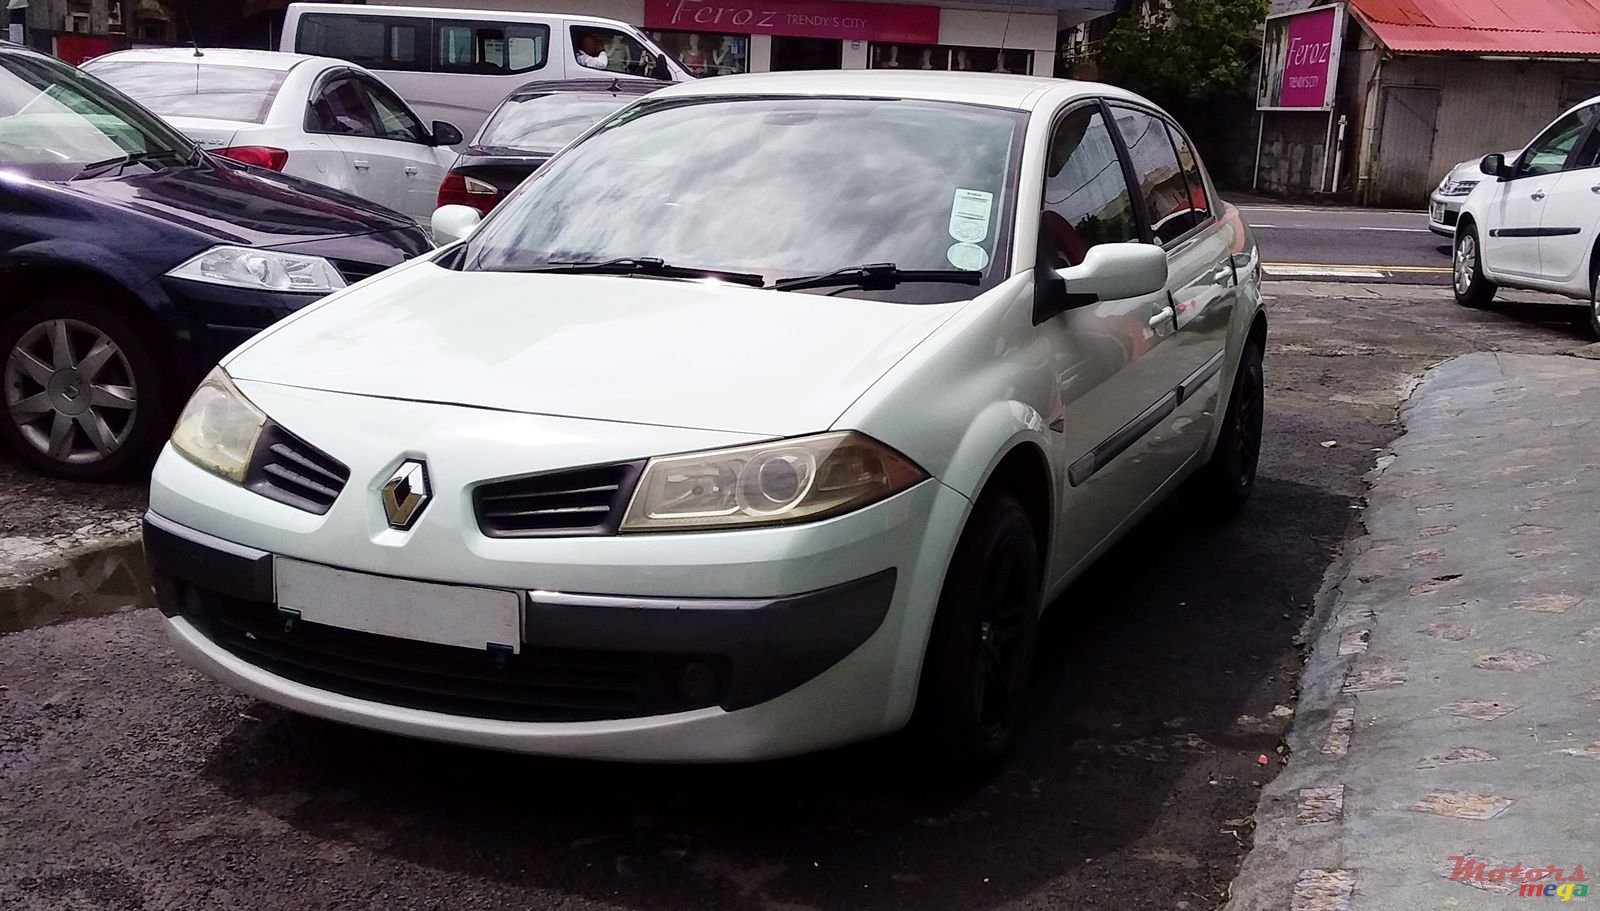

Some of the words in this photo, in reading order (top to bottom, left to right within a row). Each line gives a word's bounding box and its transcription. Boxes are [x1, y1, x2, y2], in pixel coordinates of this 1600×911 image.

[665, 0, 777, 27] Feroz
[786, 14, 840, 28] TRENDY'S
[841, 17, 867, 29] CITY
[1286, 37, 1331, 70] Feroz
